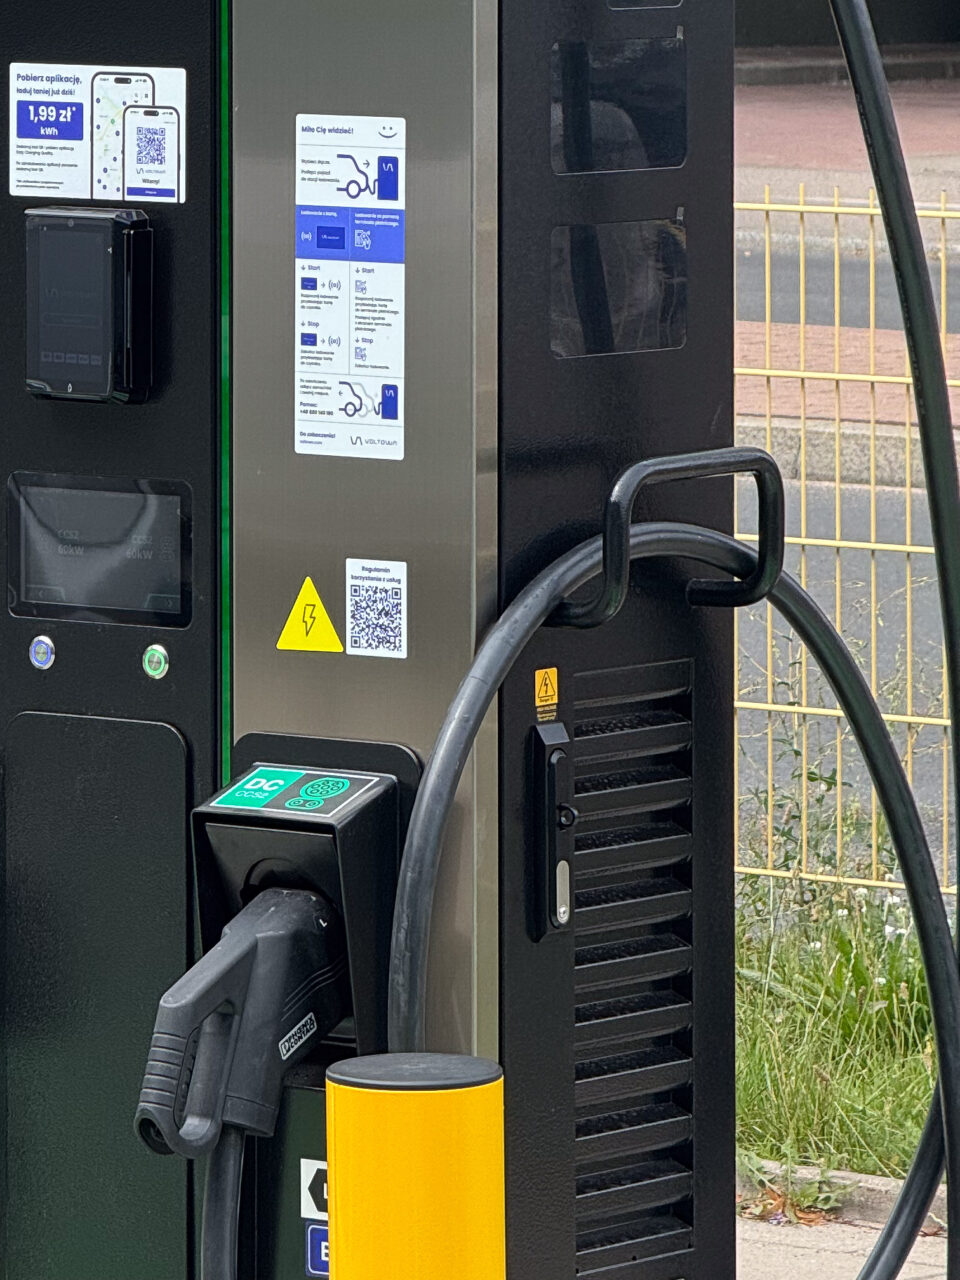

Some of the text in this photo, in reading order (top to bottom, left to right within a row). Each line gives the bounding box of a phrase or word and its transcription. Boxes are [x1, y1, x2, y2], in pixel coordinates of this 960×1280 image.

[17, 73, 82, 86] Pobierz aplikację,
[28, 105, 57, 123] 1,99
[40, 126, 58, 136] kWh
[301, 126, 316, 134] Miło
[316, 126, 326, 135] Cię
[58, 544, 85, 556] 60kW
[126, 547, 153, 560] 60kW
[243, 778, 285, 792] DC
